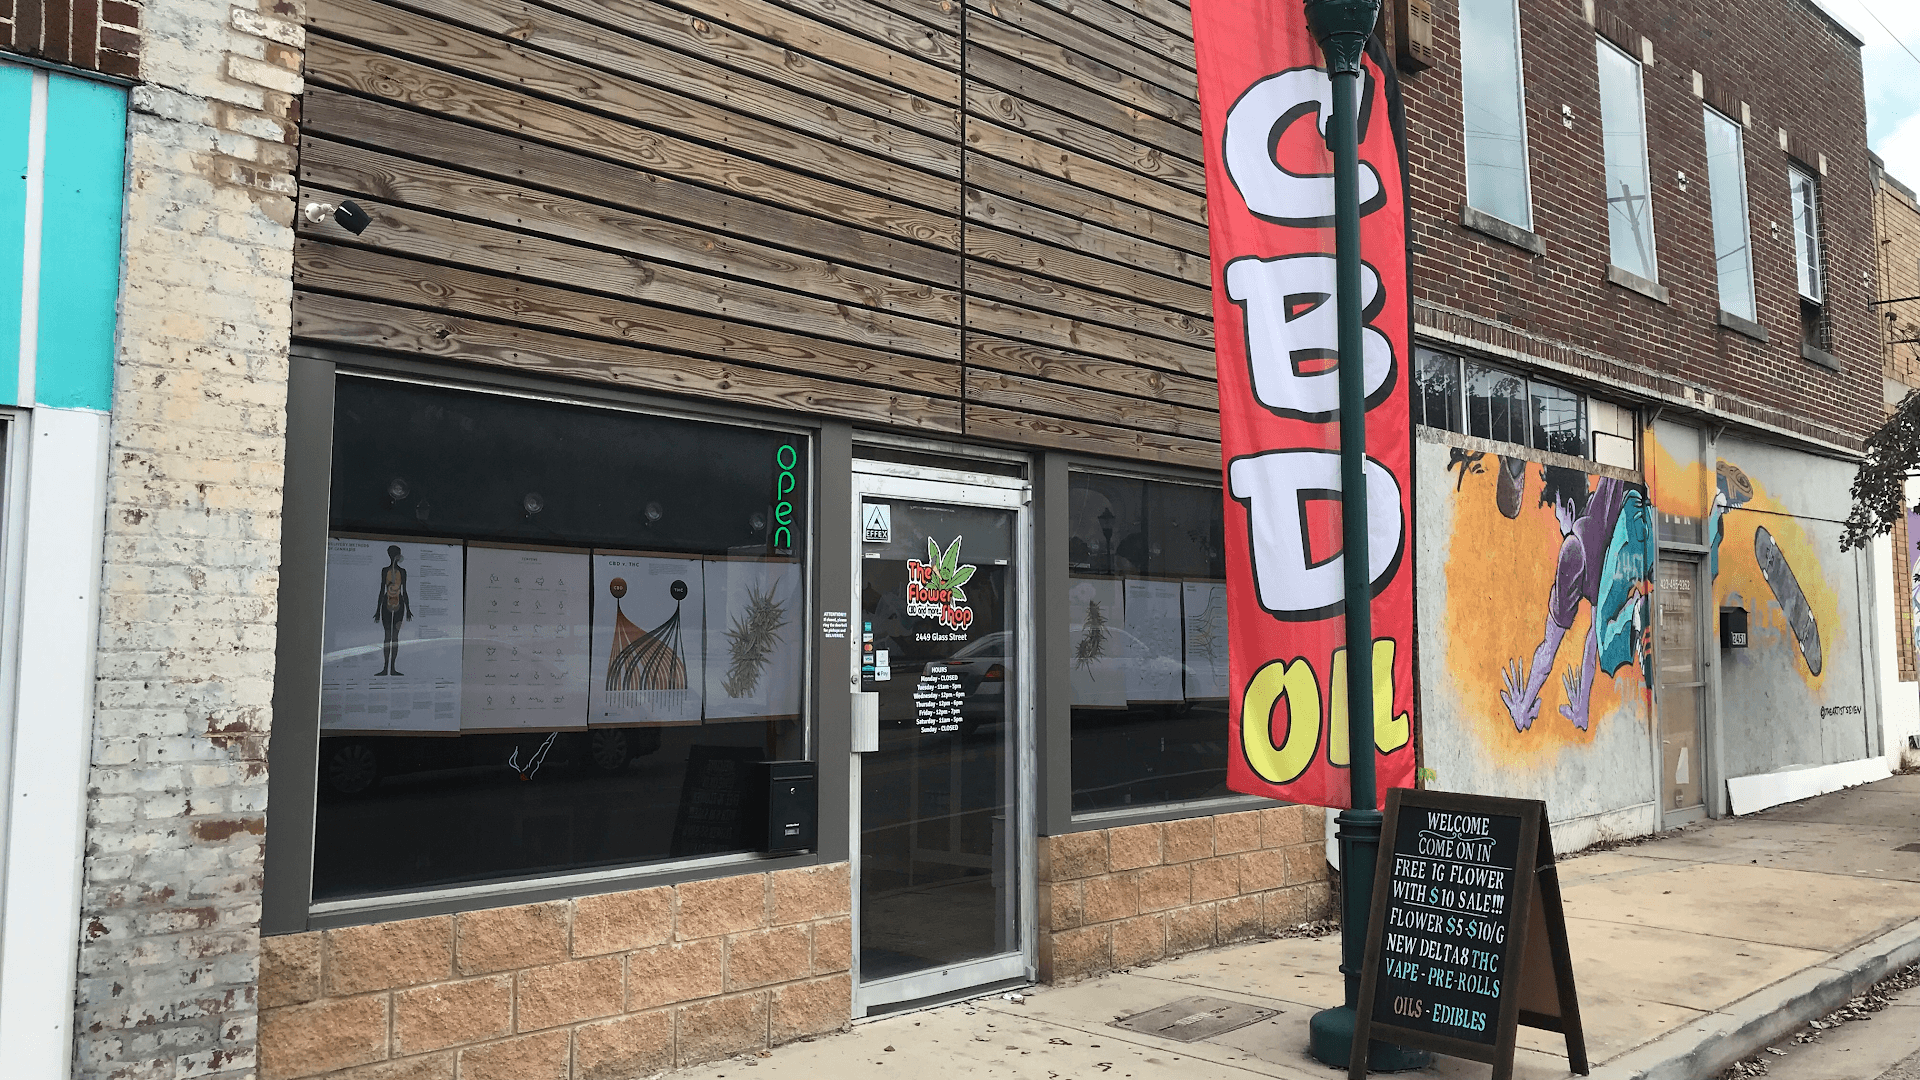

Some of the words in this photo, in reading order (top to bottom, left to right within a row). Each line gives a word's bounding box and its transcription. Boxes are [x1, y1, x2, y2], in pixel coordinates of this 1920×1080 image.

[1222, 66, 1403, 622] CBD
[866, 530, 888, 539] EFFEX
[908, 561, 933, 584] The
[908, 584, 953, 603] Flower
[940, 604, 972, 627] Shop
[915, 633, 931, 642] 2449
[932, 632, 948, 642] Glass
[949, 632, 967, 642] Street
[1733, 633, 1746, 645] 2451
[921, 675, 938, 683] Monday
[940, 674, 959, 682] CLOSED
[913, 692, 938, 700] Wednesday
[915, 717, 936, 725] Saturday
[919, 709, 933, 717] Friday
[940, 724, 959, 732] CLOSED
[1427, 811, 1490, 836] WELCOME
[1418, 837, 1454, 858] COME
[1456, 842, 1475, 861] ON
[1477, 843, 1492, 862] IN
[1394, 858, 1427, 879] FREE
[1431, 862, 1445, 882] 1G
[1449, 864, 1504, 890] FLOWER
[1393, 880, 1427, 903] WITH
[1458, 890, 1505, 915] SALE!!!
[1389, 907, 1444, 934] FLOWER
[1386, 932, 1418, 955] NEW
[1471, 949, 1499, 973] THC
[1386, 957, 1419, 982] VAPE
[1427, 966, 1501, 999] PRE-ROLLS
[1394, 995, 1423, 1019] OILS
[1432, 1003, 1487, 1032] EDIBLES
